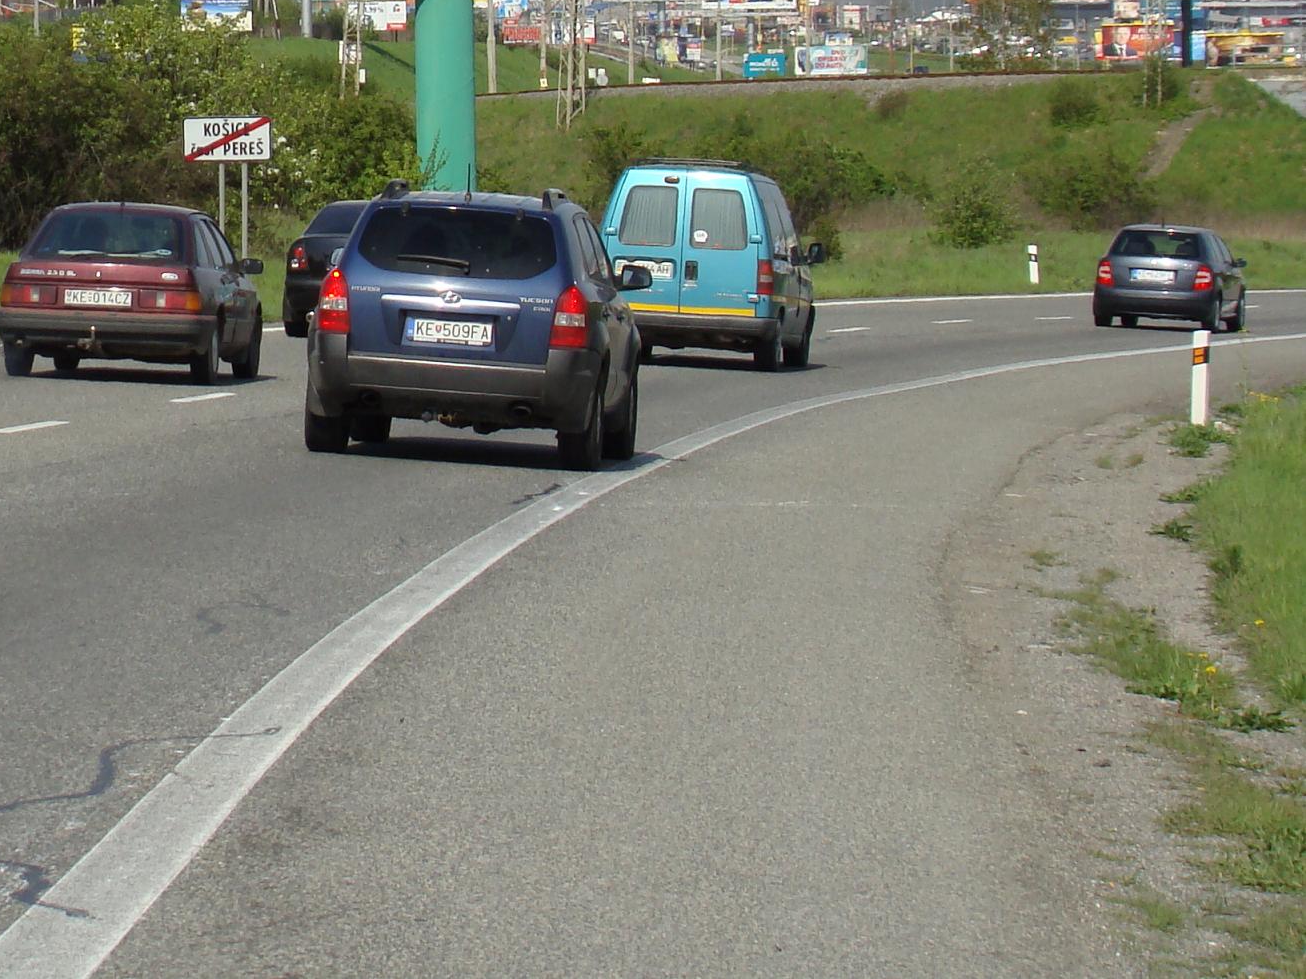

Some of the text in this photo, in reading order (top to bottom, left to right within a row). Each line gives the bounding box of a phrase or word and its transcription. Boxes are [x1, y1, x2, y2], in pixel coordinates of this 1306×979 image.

[224, 138, 264, 156] PEREŠ
[416, 325, 489, 341] KE 509FA
